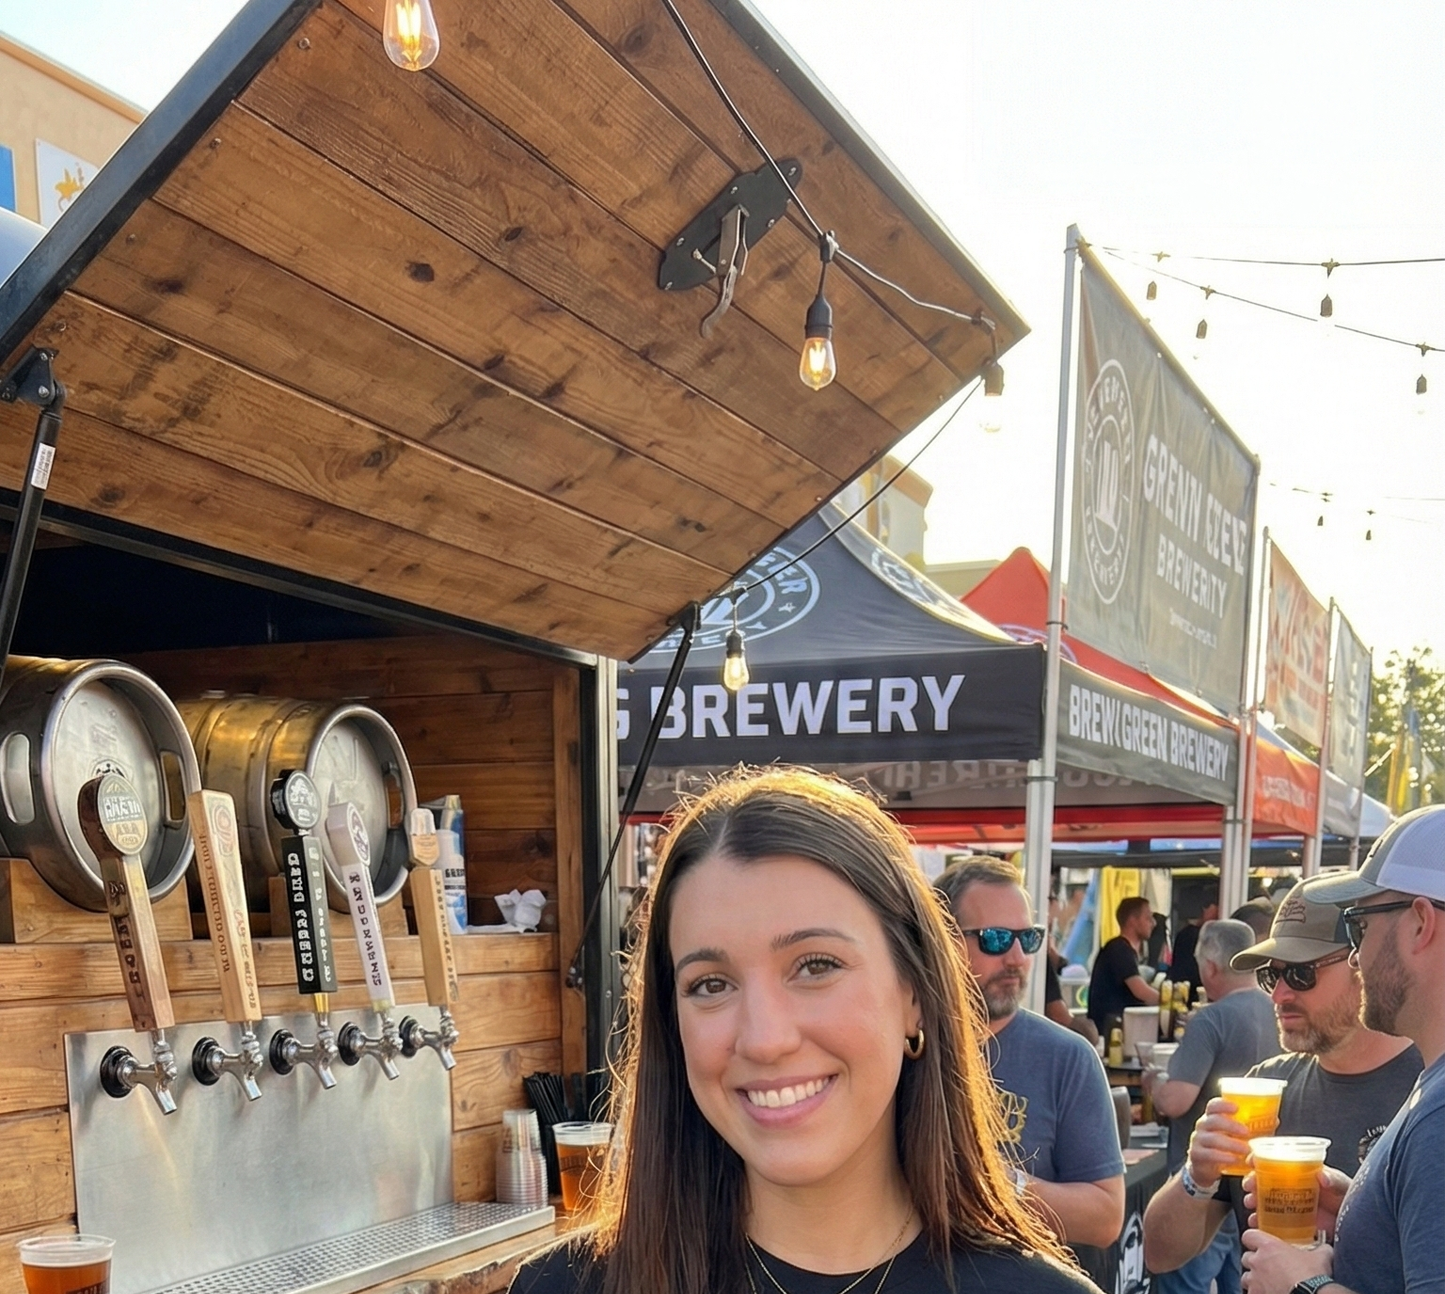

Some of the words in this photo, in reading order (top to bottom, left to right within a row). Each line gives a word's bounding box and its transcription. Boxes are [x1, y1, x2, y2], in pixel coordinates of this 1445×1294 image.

[651, 675, 965, 740] BREWERY
[1122, 703, 1168, 762] GREEN
[1171, 721, 1229, 781] BREWERY
